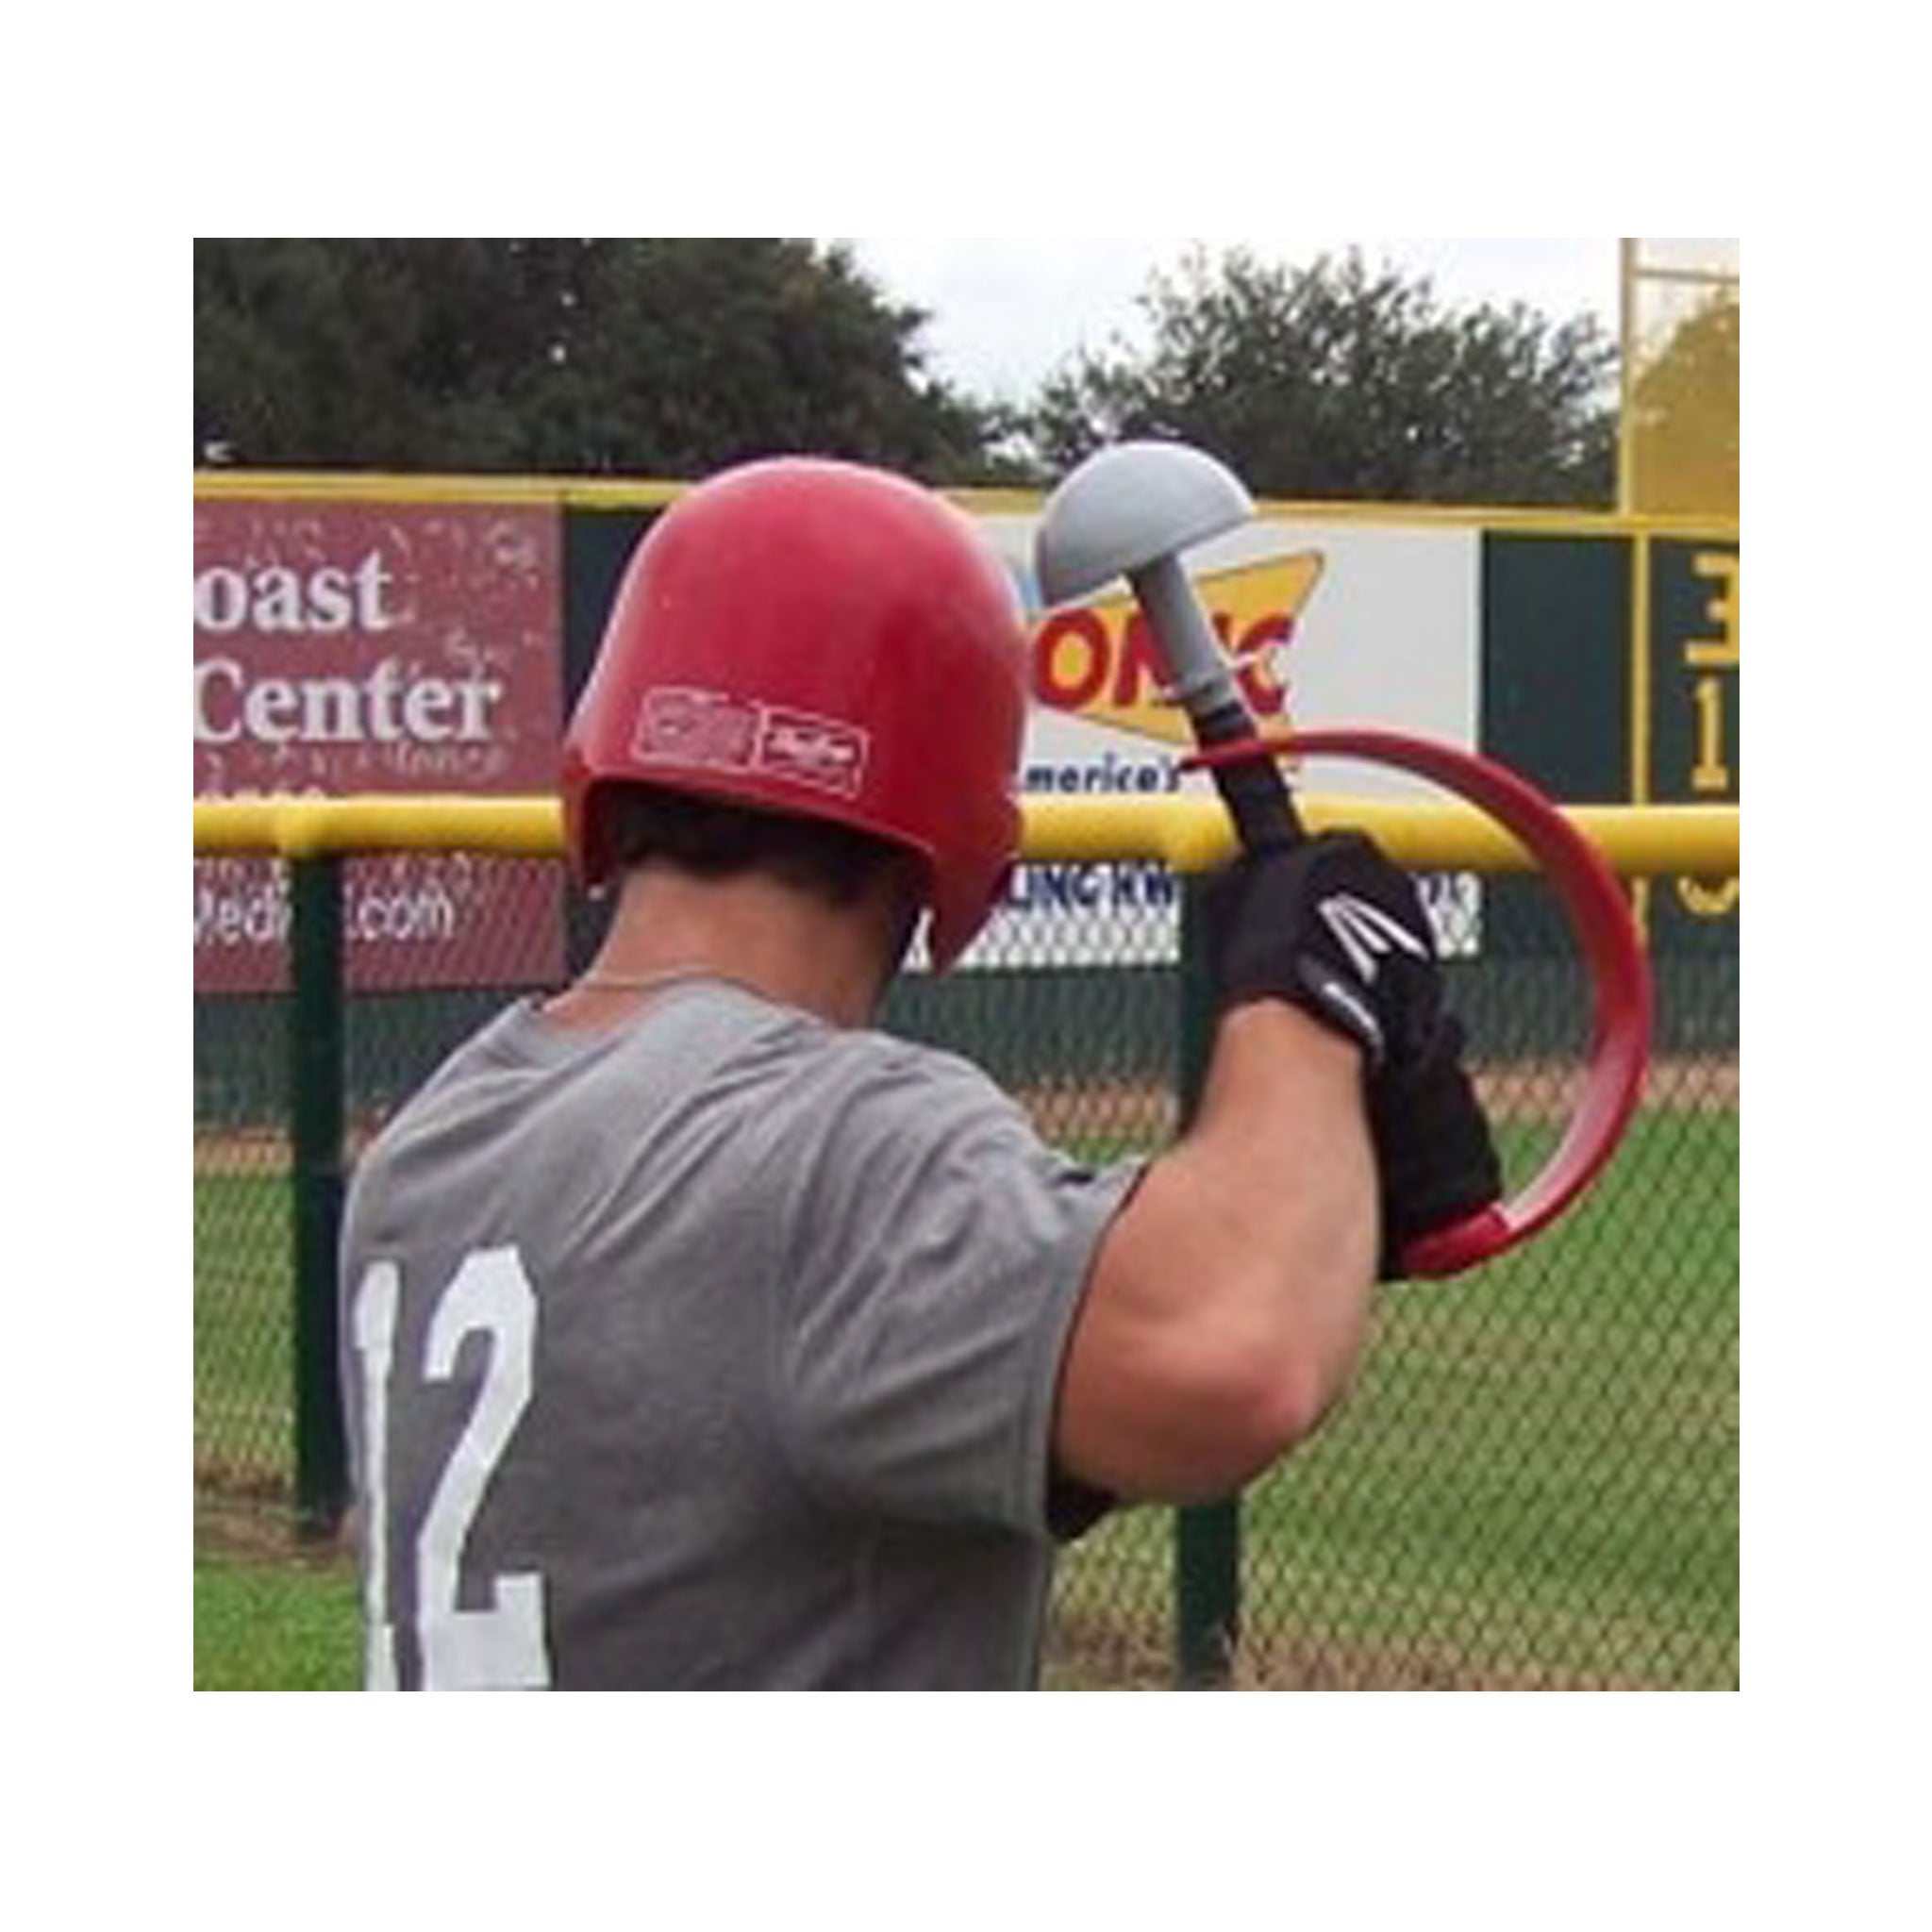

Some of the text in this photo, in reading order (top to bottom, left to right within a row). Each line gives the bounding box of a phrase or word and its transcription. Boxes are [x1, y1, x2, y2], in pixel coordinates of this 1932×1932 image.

[193, 658, 503, 742] Center
[1031, 607, 1296, 716] ONC
[355, 1245, 551, 1691] 12
